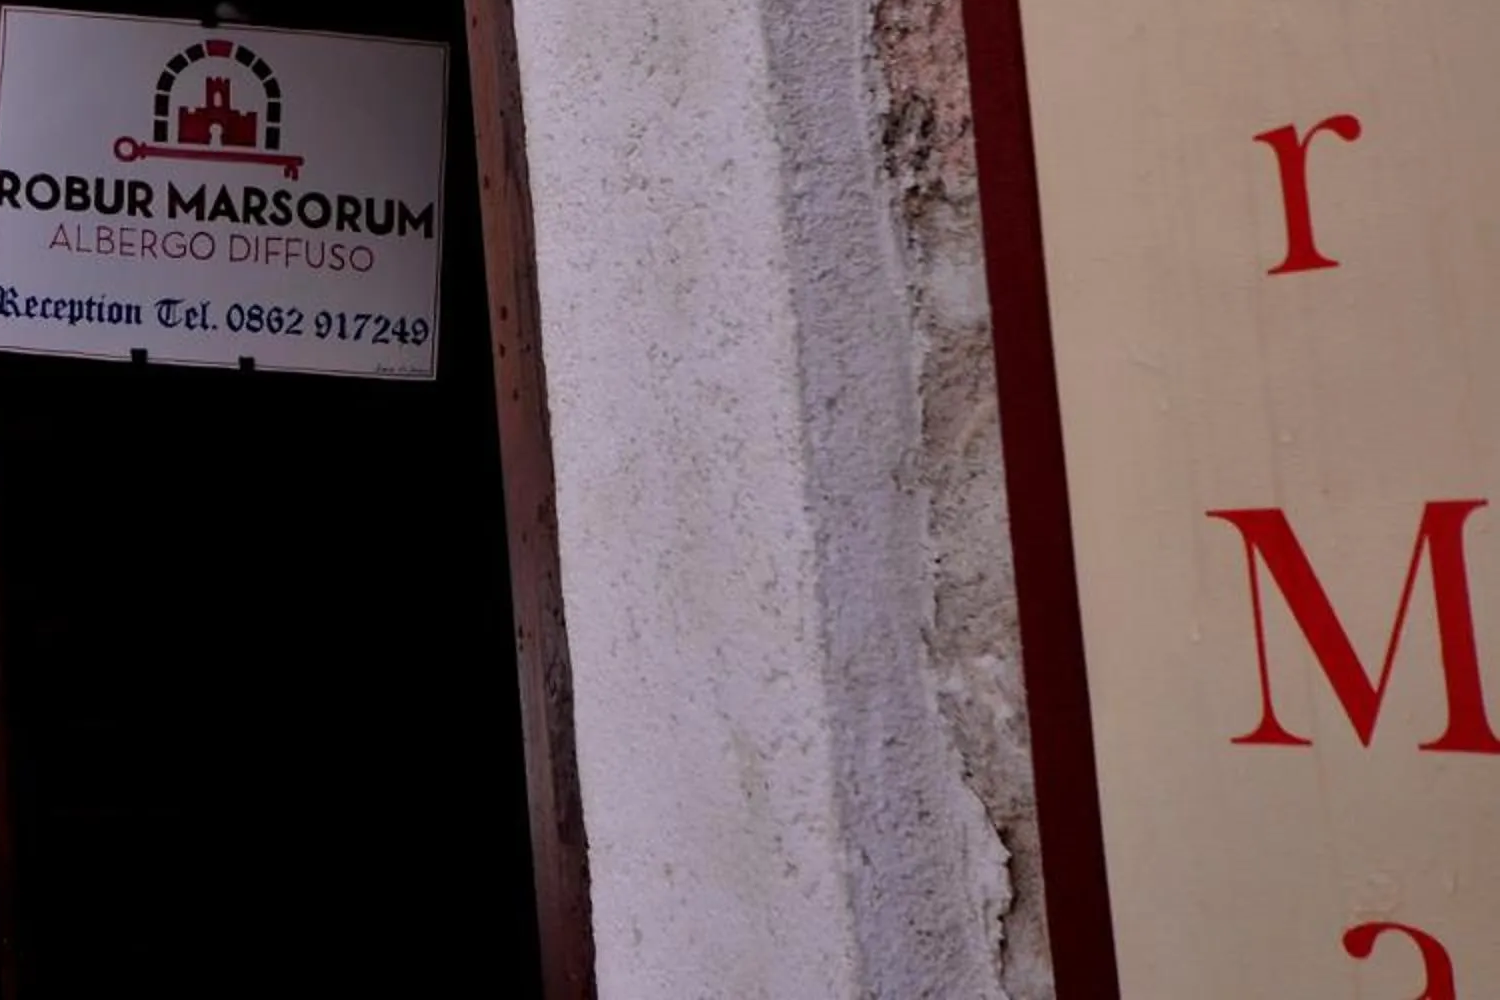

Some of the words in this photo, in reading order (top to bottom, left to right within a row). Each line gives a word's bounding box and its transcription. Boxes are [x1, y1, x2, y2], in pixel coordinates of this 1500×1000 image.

[167, 180, 435, 239] MARSORUM
[48, 222, 216, 261] ALBERGO
[228, 234, 375, 273] DIFFUSO
[155, 297, 219, 332] Tel.
[226, 302, 305, 336] 0862
[314, 308, 430, 346] 917249
